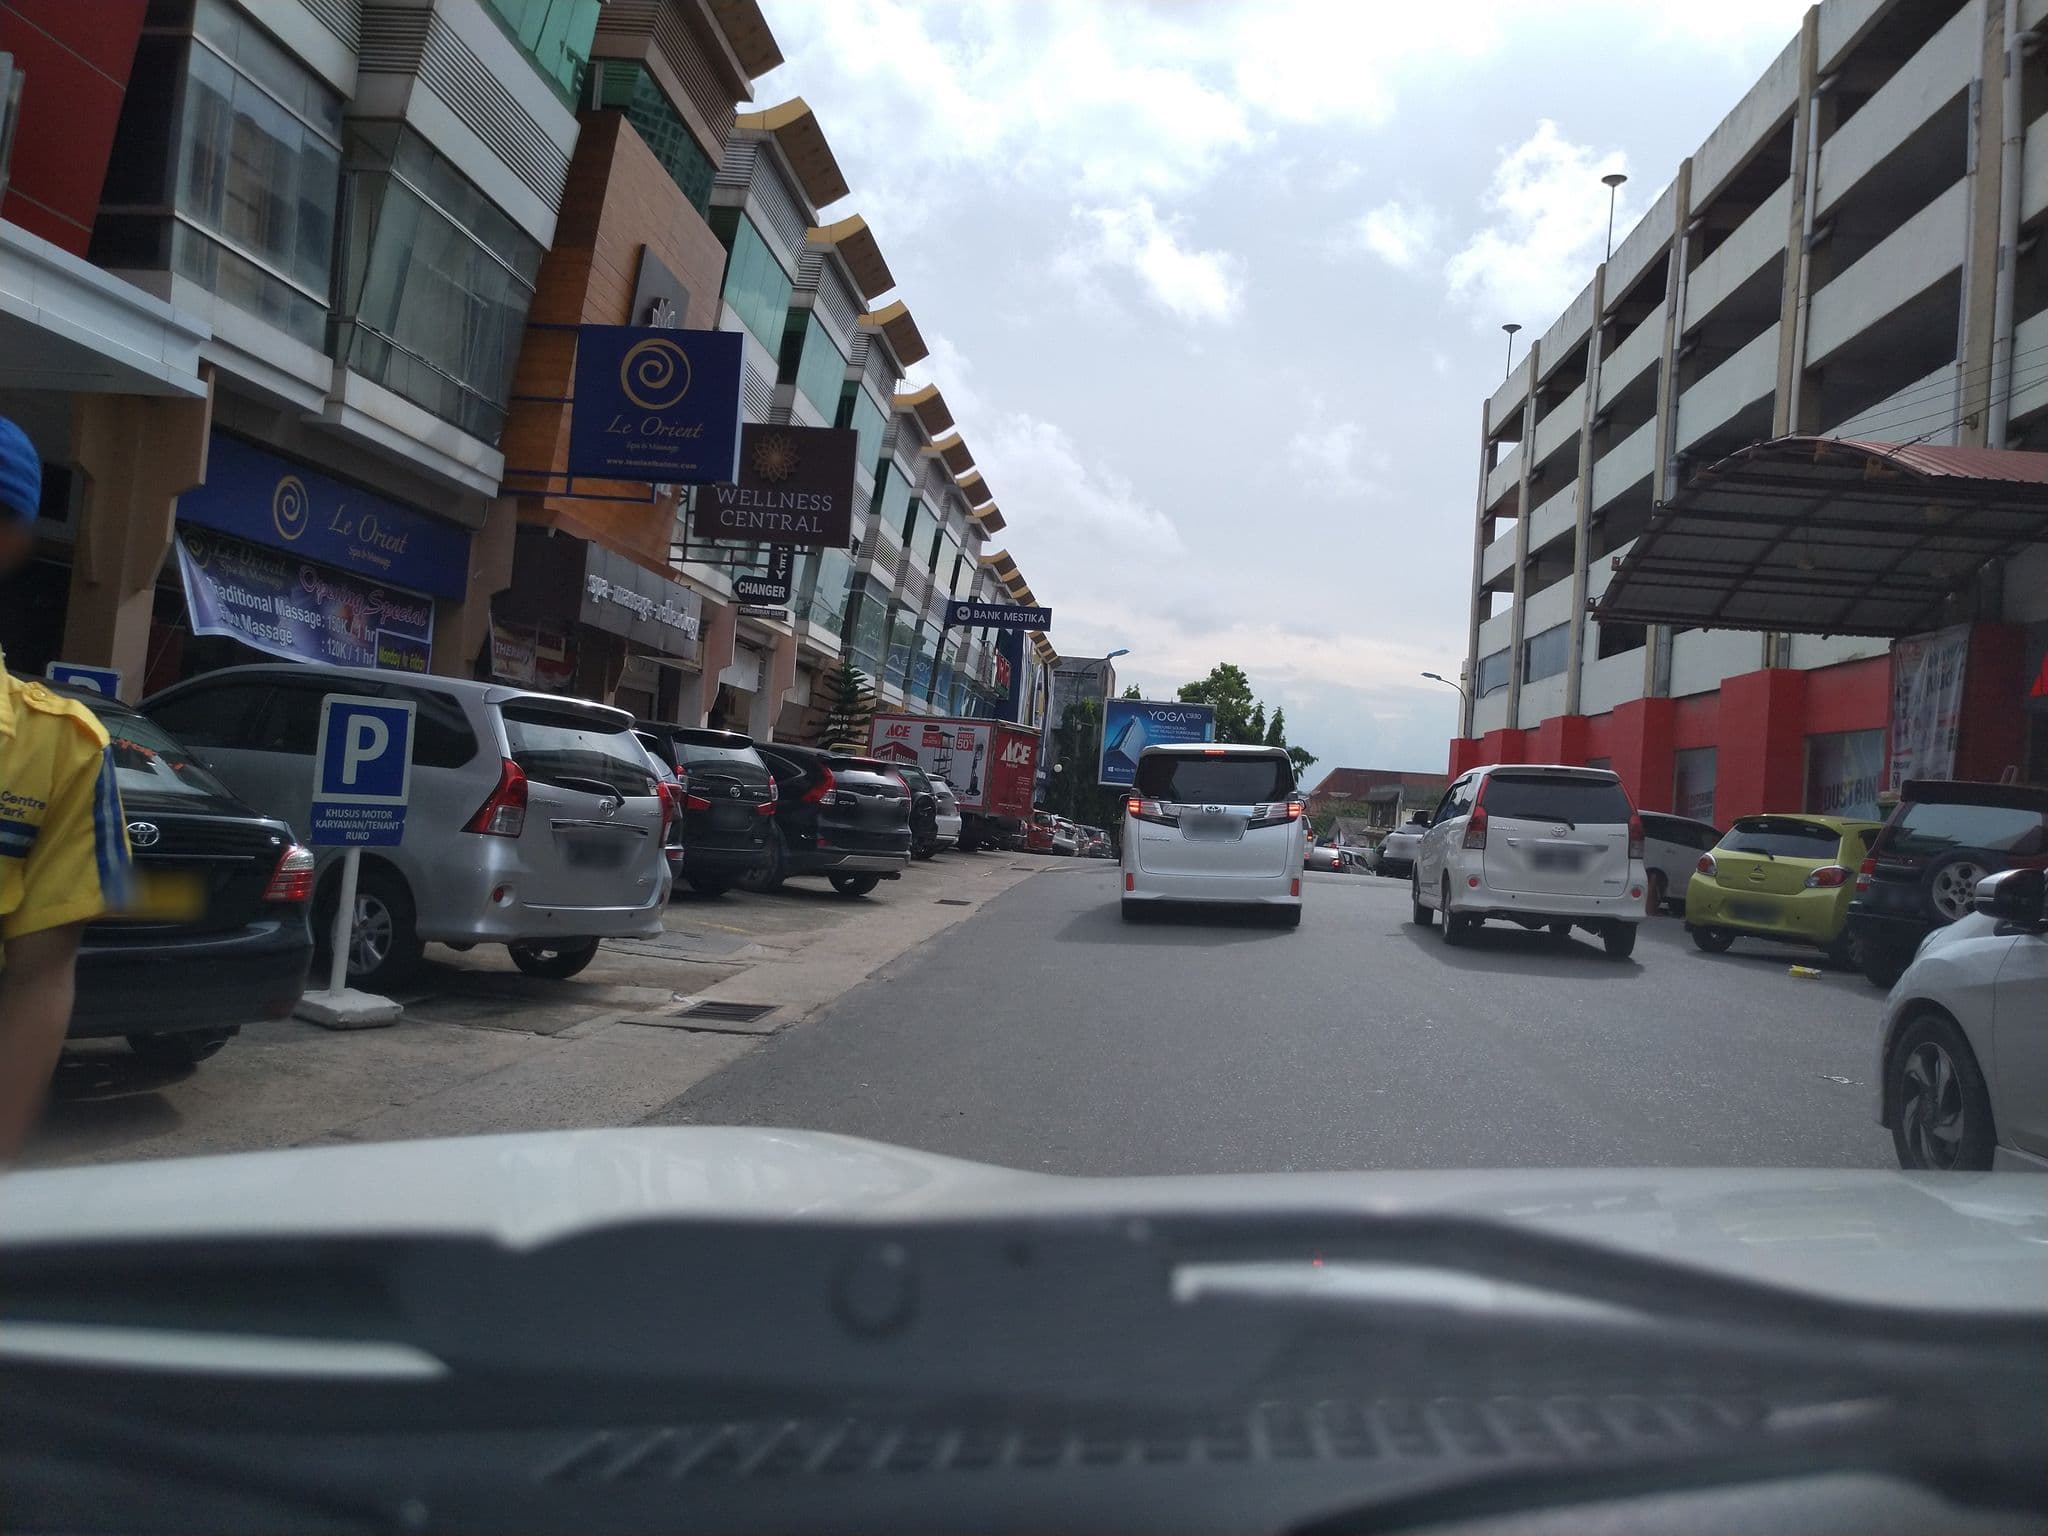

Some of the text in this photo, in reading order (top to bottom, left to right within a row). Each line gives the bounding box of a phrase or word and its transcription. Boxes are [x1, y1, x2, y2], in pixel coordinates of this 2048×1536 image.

[604, 414, 704, 439] Le Orient
[717, 487, 833, 512] WELLNESS
[328, 504, 409, 554] Le Orient
[720, 509, 823, 533] CENTRAL
[206, 576, 273, 613] Traditional
[738, 581, 786, 599] CHANGER
[973, 609, 1001, 621] BANK
[1003, 612, 1046, 624] MESTIKA
[240, 613, 293, 648] Massage
[1148, 711, 1186, 723] YOGA
[886, 723, 911, 738] ACE
[342, 714, 389, 785] P
[1001, 738, 1032, 765] ACE
[1, 790, 46, 810] Centre
[325, 808, 393, 819] KHUSUS MOTOR
[315, 819, 401, 831] KARYAWAN/TENANT
[345, 832, 370, 841] RUKO
